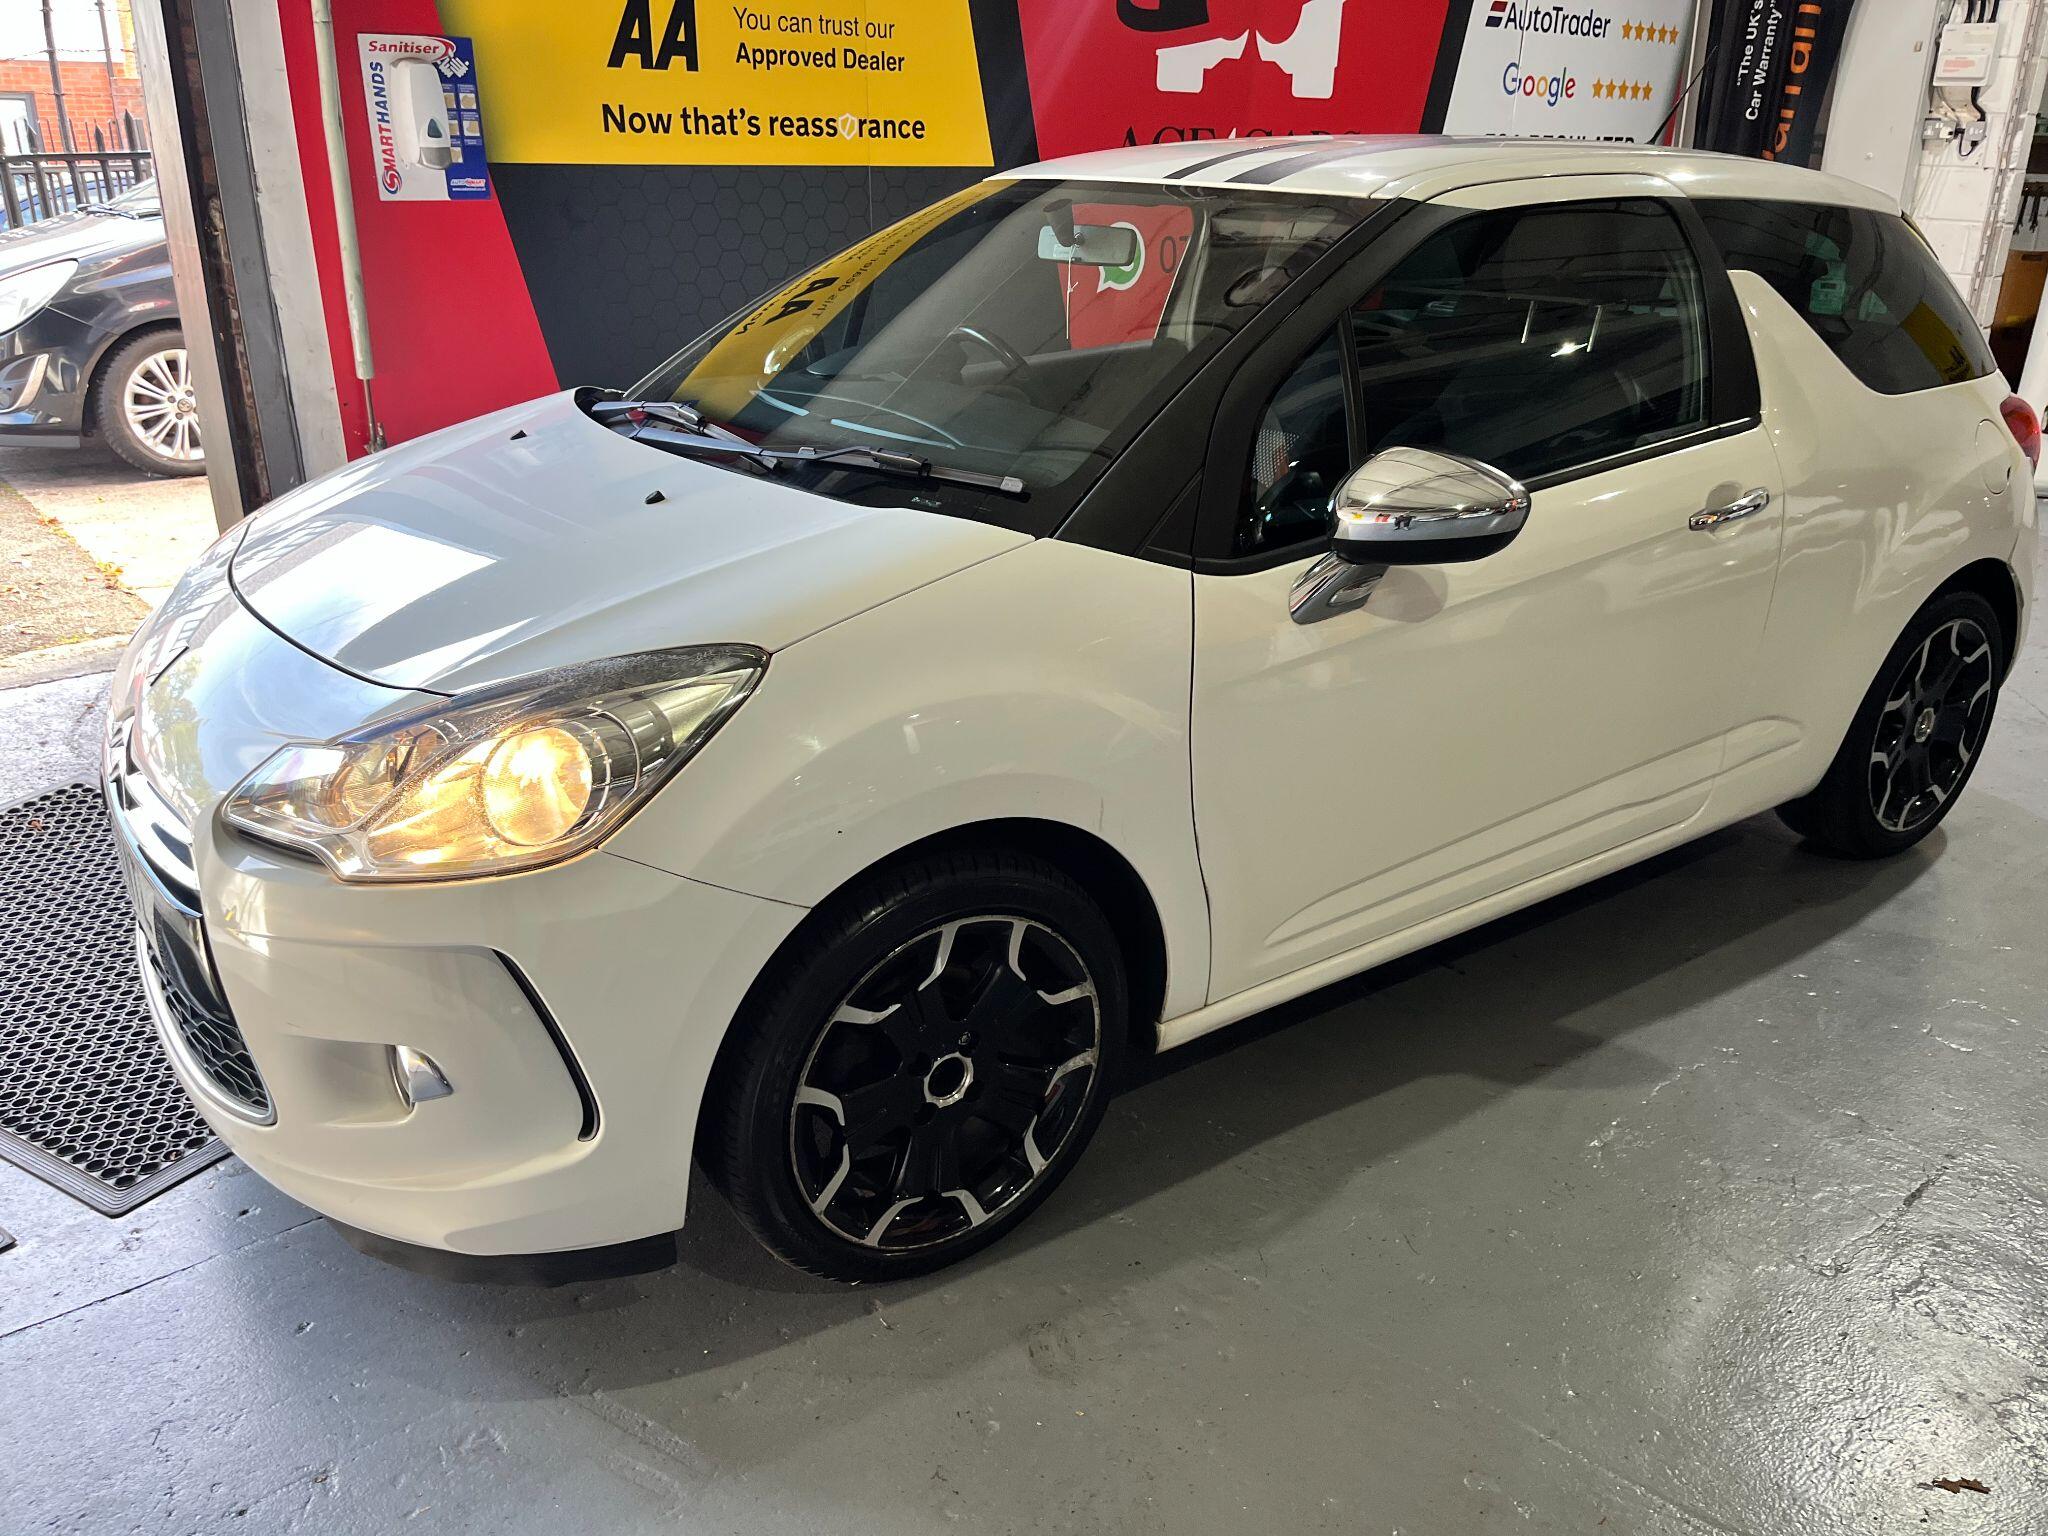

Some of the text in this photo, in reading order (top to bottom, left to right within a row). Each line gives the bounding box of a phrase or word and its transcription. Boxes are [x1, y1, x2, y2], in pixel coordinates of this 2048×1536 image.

[607, 0, 699, 72] AA
[733, 6, 895, 39] You can trust our
[1504, 2, 1611, 38] AutoTrader
[368, 40, 440, 54] Sanitiser
[735, 42, 905, 72] Approved Dealer
[1503, 62, 1576, 107] Google
[601, 103, 672, 134] Now
[680, 107, 761, 136] that's
[1745, 90, 1763, 121] Car
[370, 60, 402, 195] SMARTHANDS
